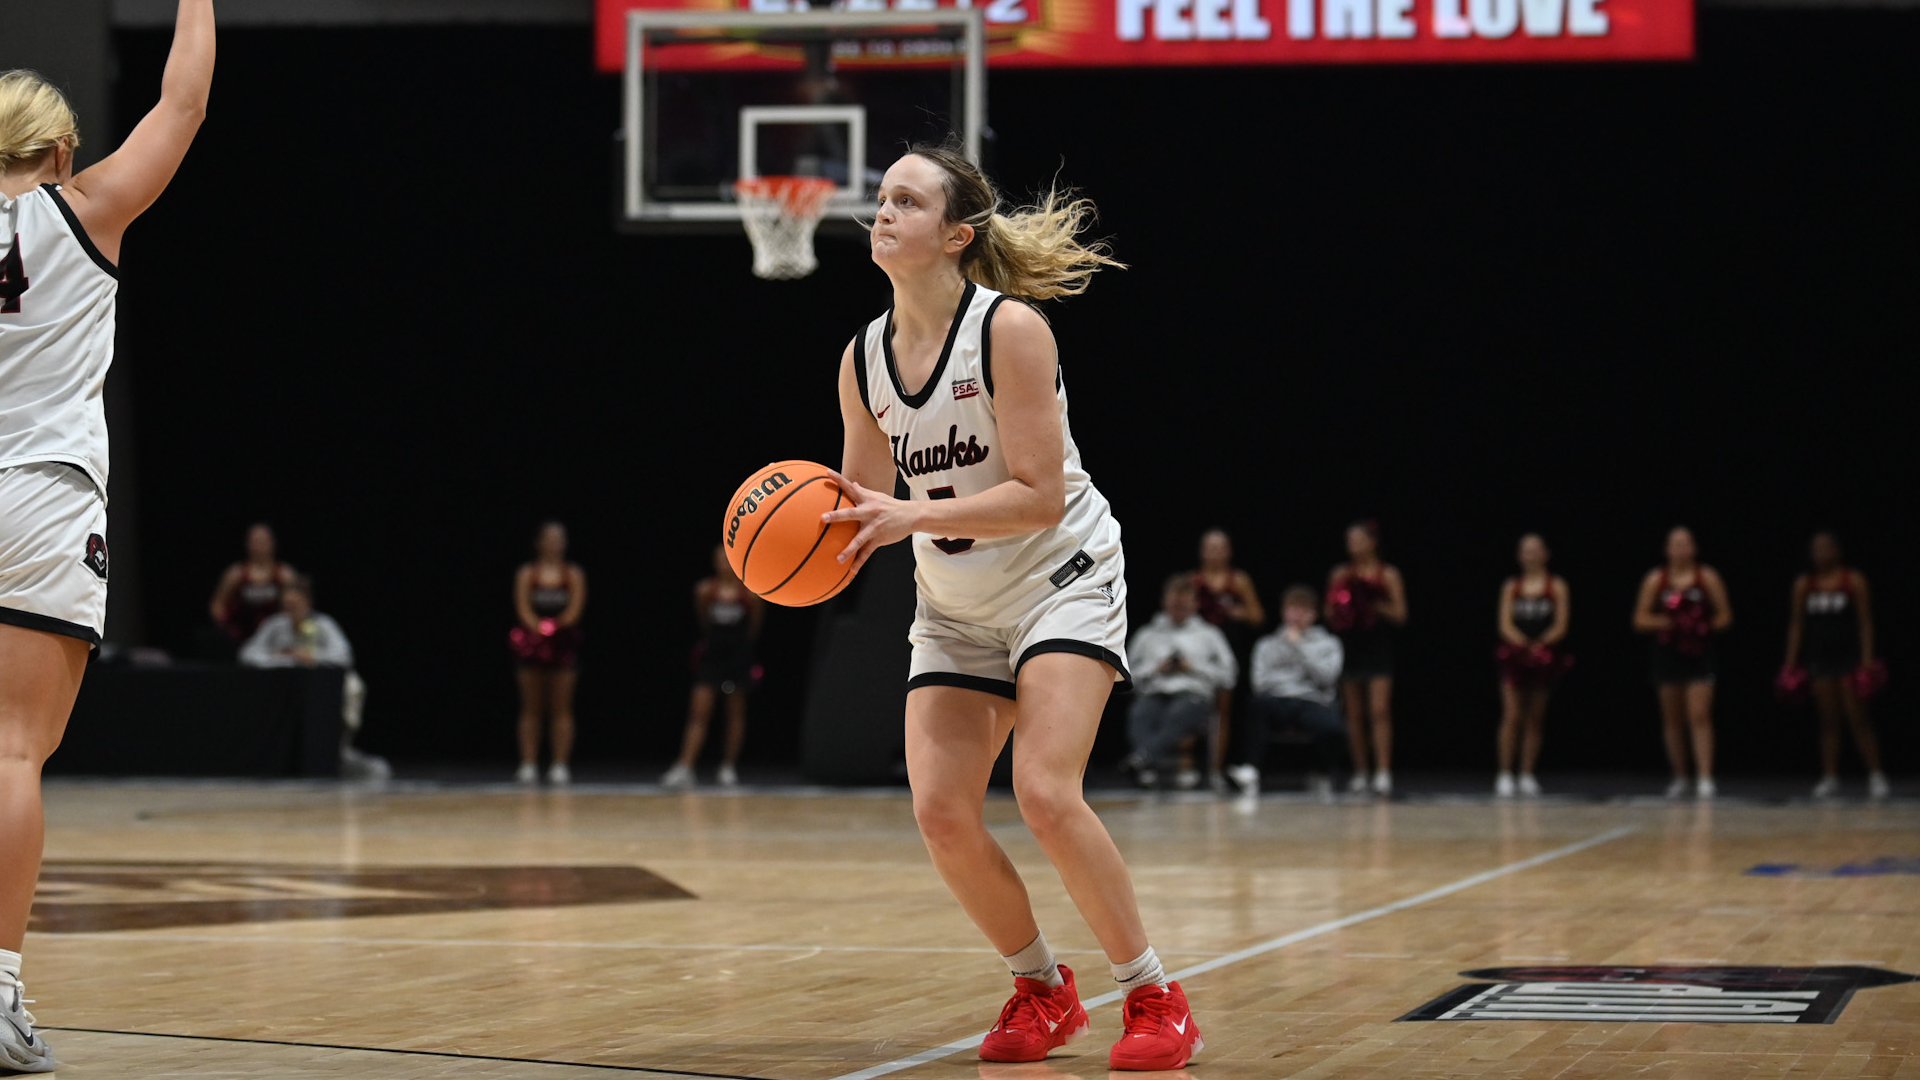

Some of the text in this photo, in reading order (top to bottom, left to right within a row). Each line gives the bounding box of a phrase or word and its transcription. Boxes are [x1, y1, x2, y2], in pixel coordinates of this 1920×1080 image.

[1117, 0, 1271, 40] FEEL
[1432, 0, 1609, 39] LOVE
[952, 381, 979, 396] PSAC
[891, 424, 989, 478] Hawks
[726, 471, 794, 549] Wilson
